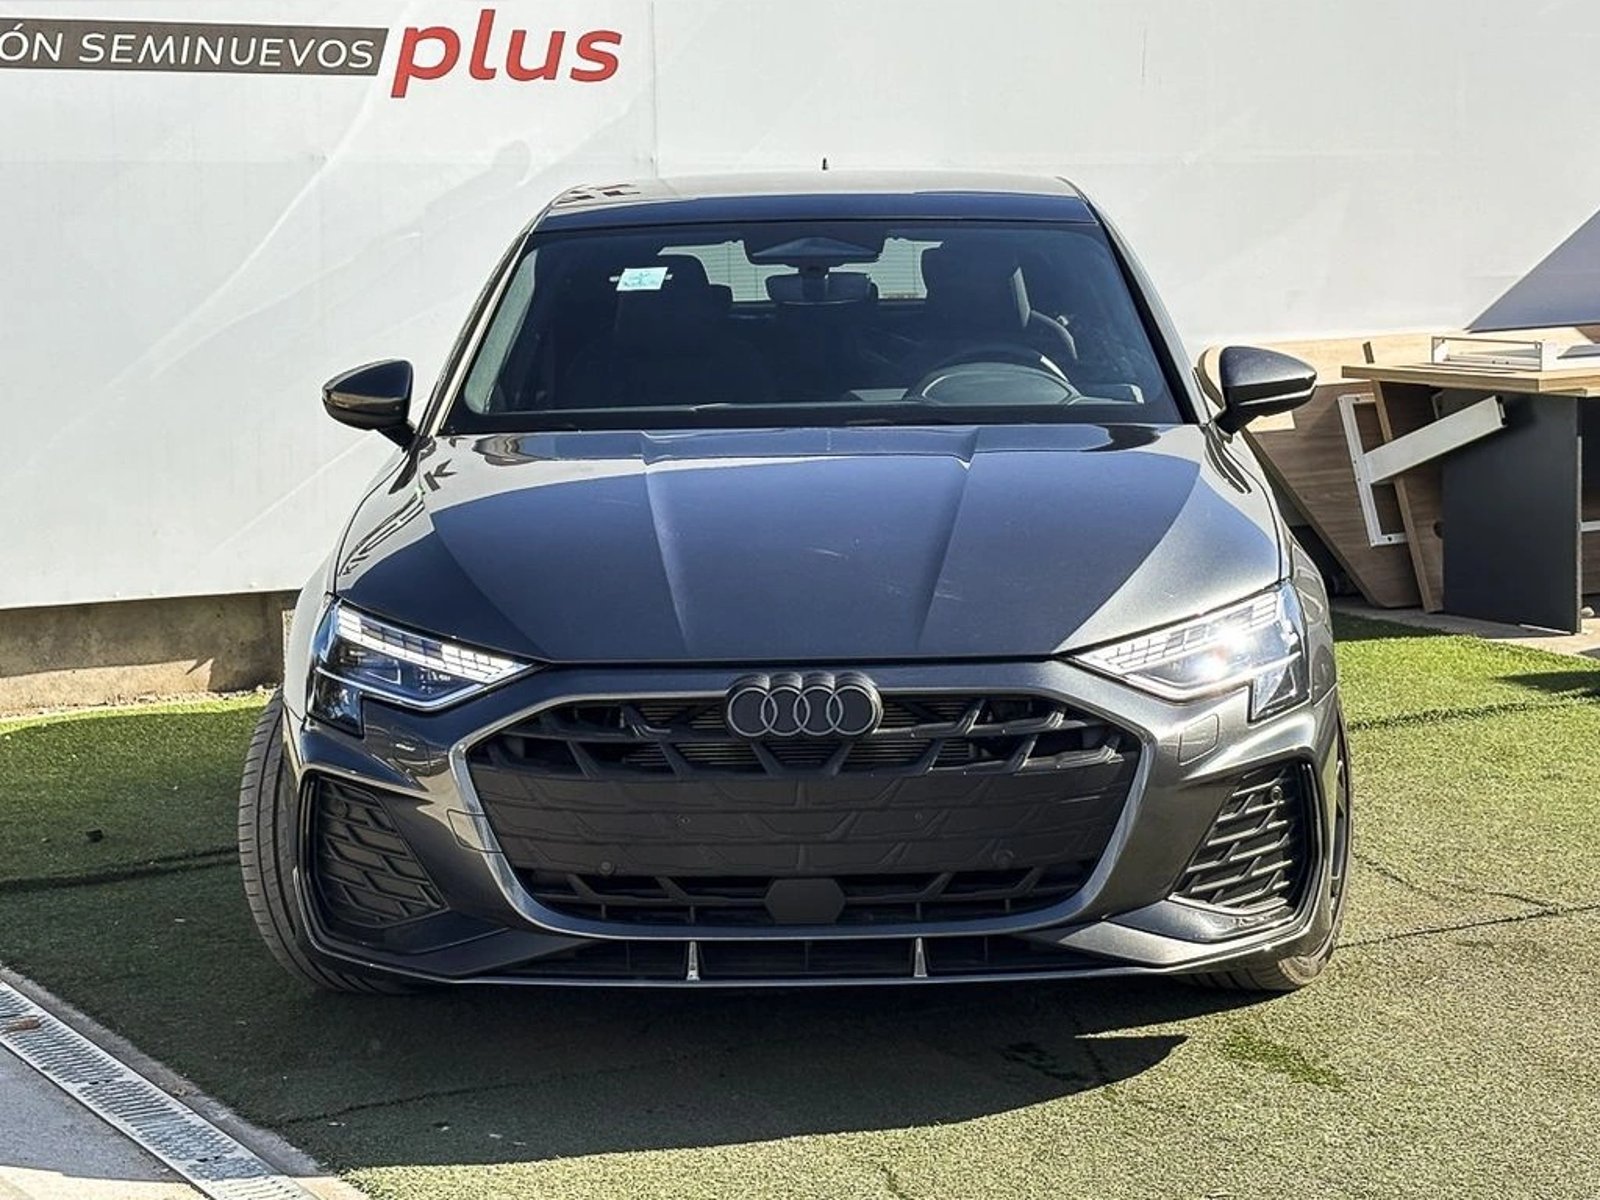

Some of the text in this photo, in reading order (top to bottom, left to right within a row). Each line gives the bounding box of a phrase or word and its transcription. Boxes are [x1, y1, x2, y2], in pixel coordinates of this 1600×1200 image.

[0, 9, 622, 98] ÓN SEMINUEVOS plus
